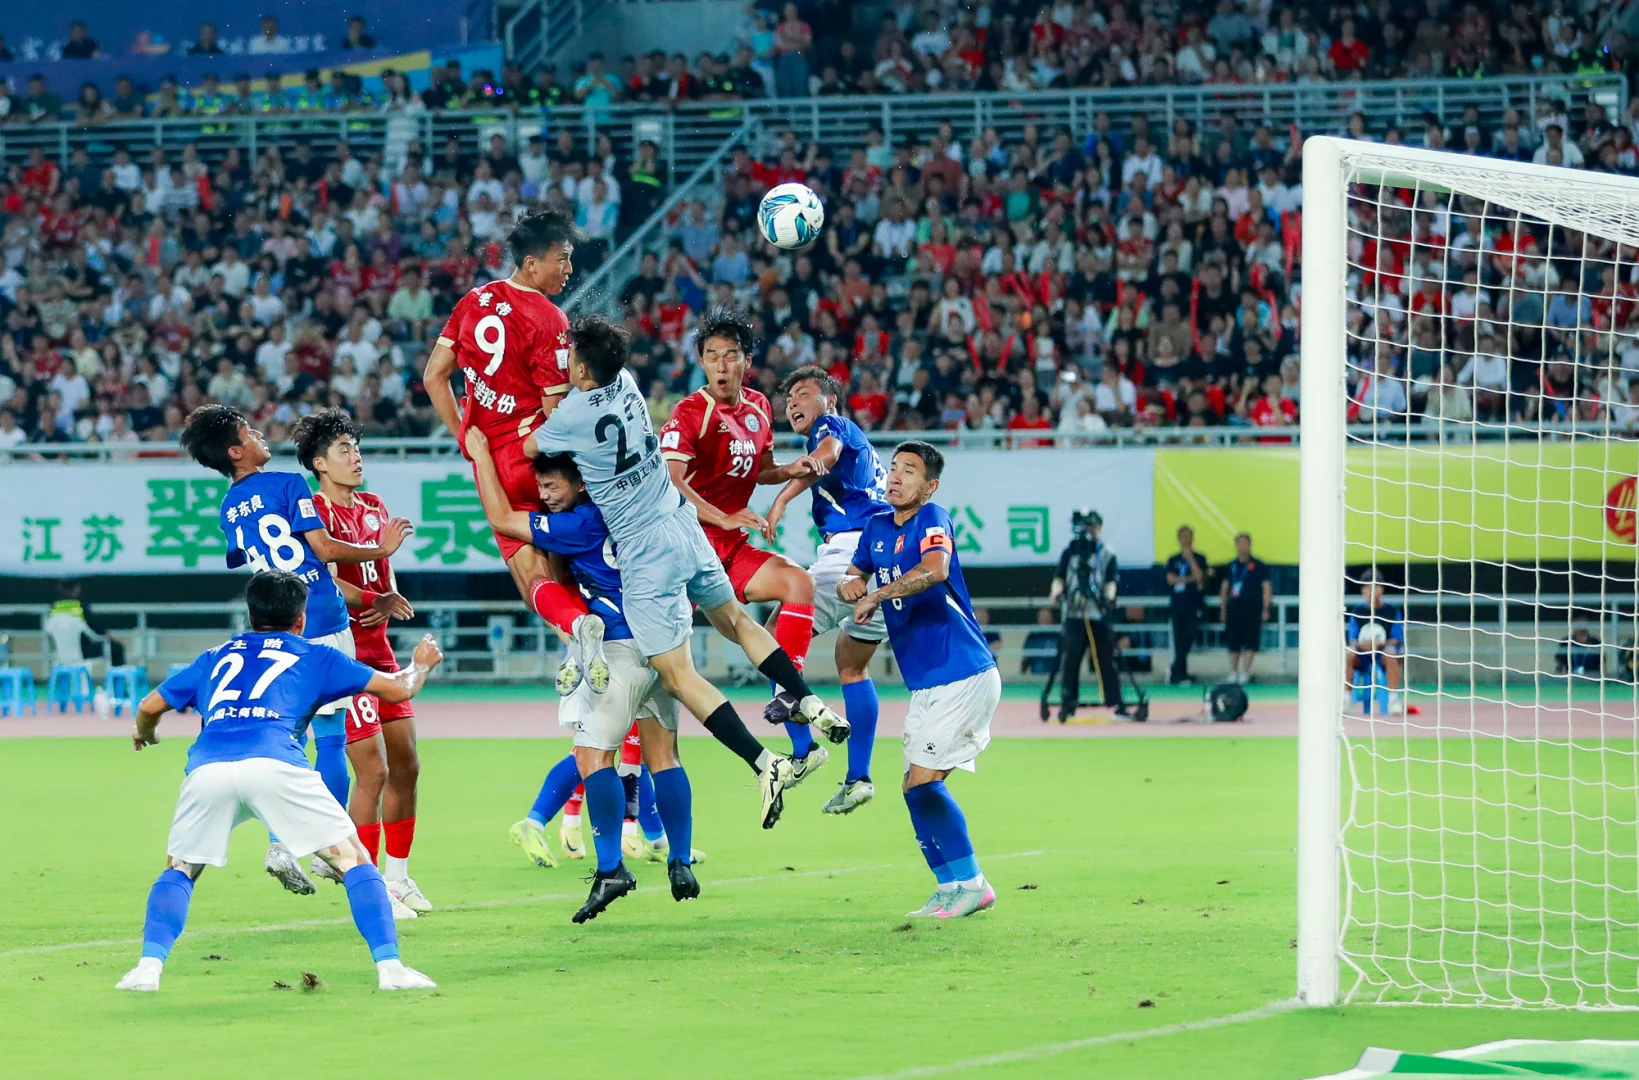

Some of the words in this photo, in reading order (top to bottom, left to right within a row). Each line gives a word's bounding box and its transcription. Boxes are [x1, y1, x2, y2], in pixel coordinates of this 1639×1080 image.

[474, 314, 506, 376] 9
[728, 439, 757, 456] 徐州
[726, 456, 754, 478] 29
[226, 494, 264, 523] 李东良
[22, 515, 124, 563] 江苏
[235, 513, 305, 574] 48
[929, 535, 944, 546] C
[360, 560, 378, 585] 18
[879, 565, 903, 584] 扬州
[208, 649, 301, 712] 27
[349, 696, 377, 729] 18
